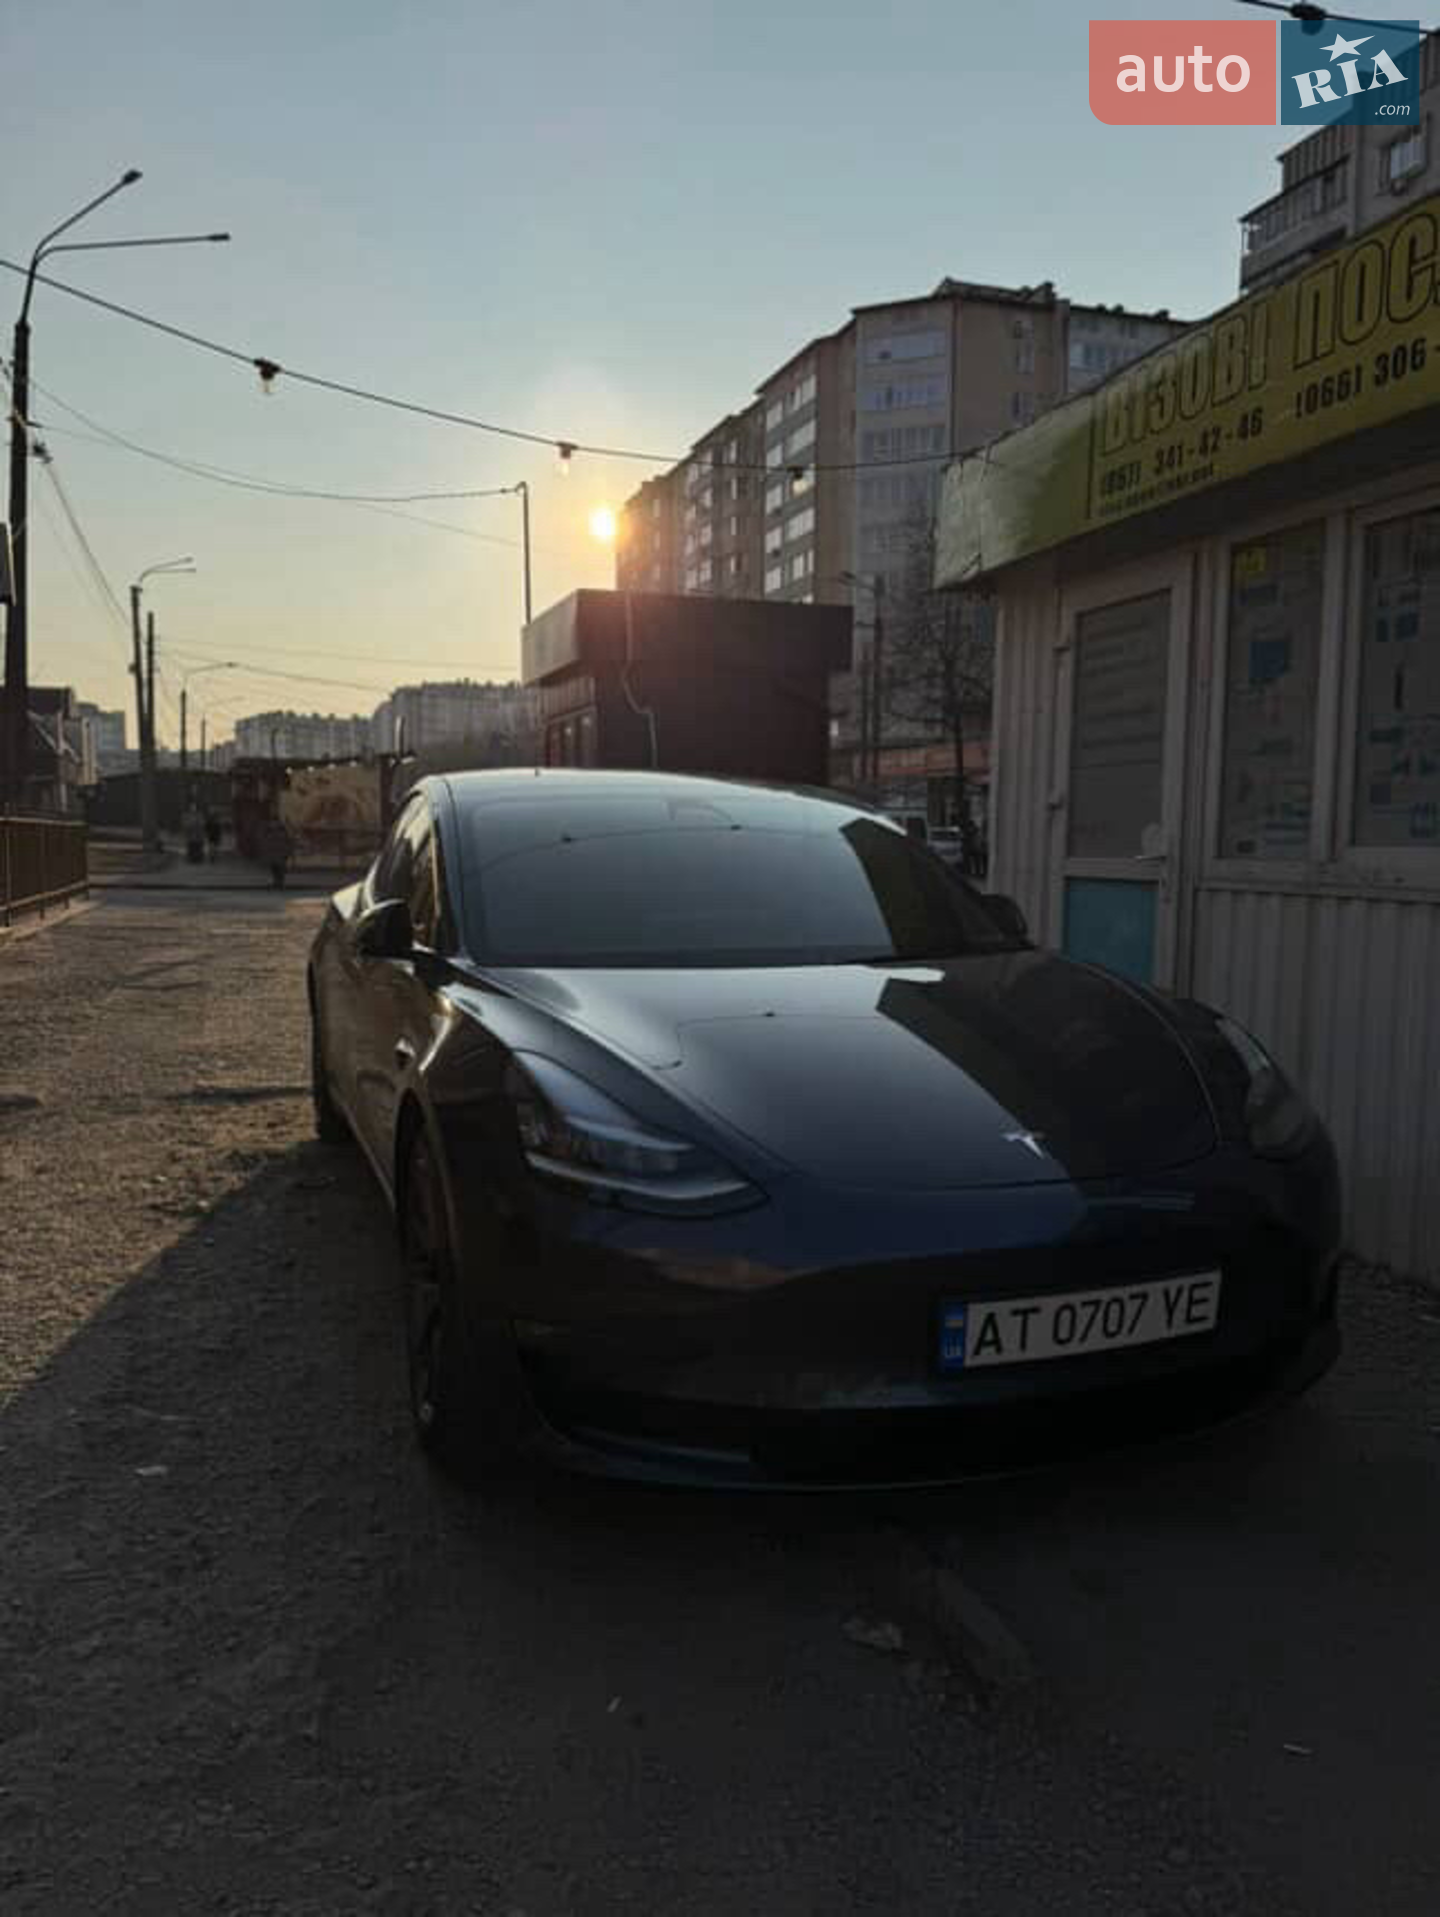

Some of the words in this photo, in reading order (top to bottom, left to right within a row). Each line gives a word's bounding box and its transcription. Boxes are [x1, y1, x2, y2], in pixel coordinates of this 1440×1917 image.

[1292, 212, 1440, 371] ПОС
[972, 1305, 1042, 1357] AT
[1052, 1292, 1149, 1346] 0707
[1163, 1281, 1214, 1330] YE
